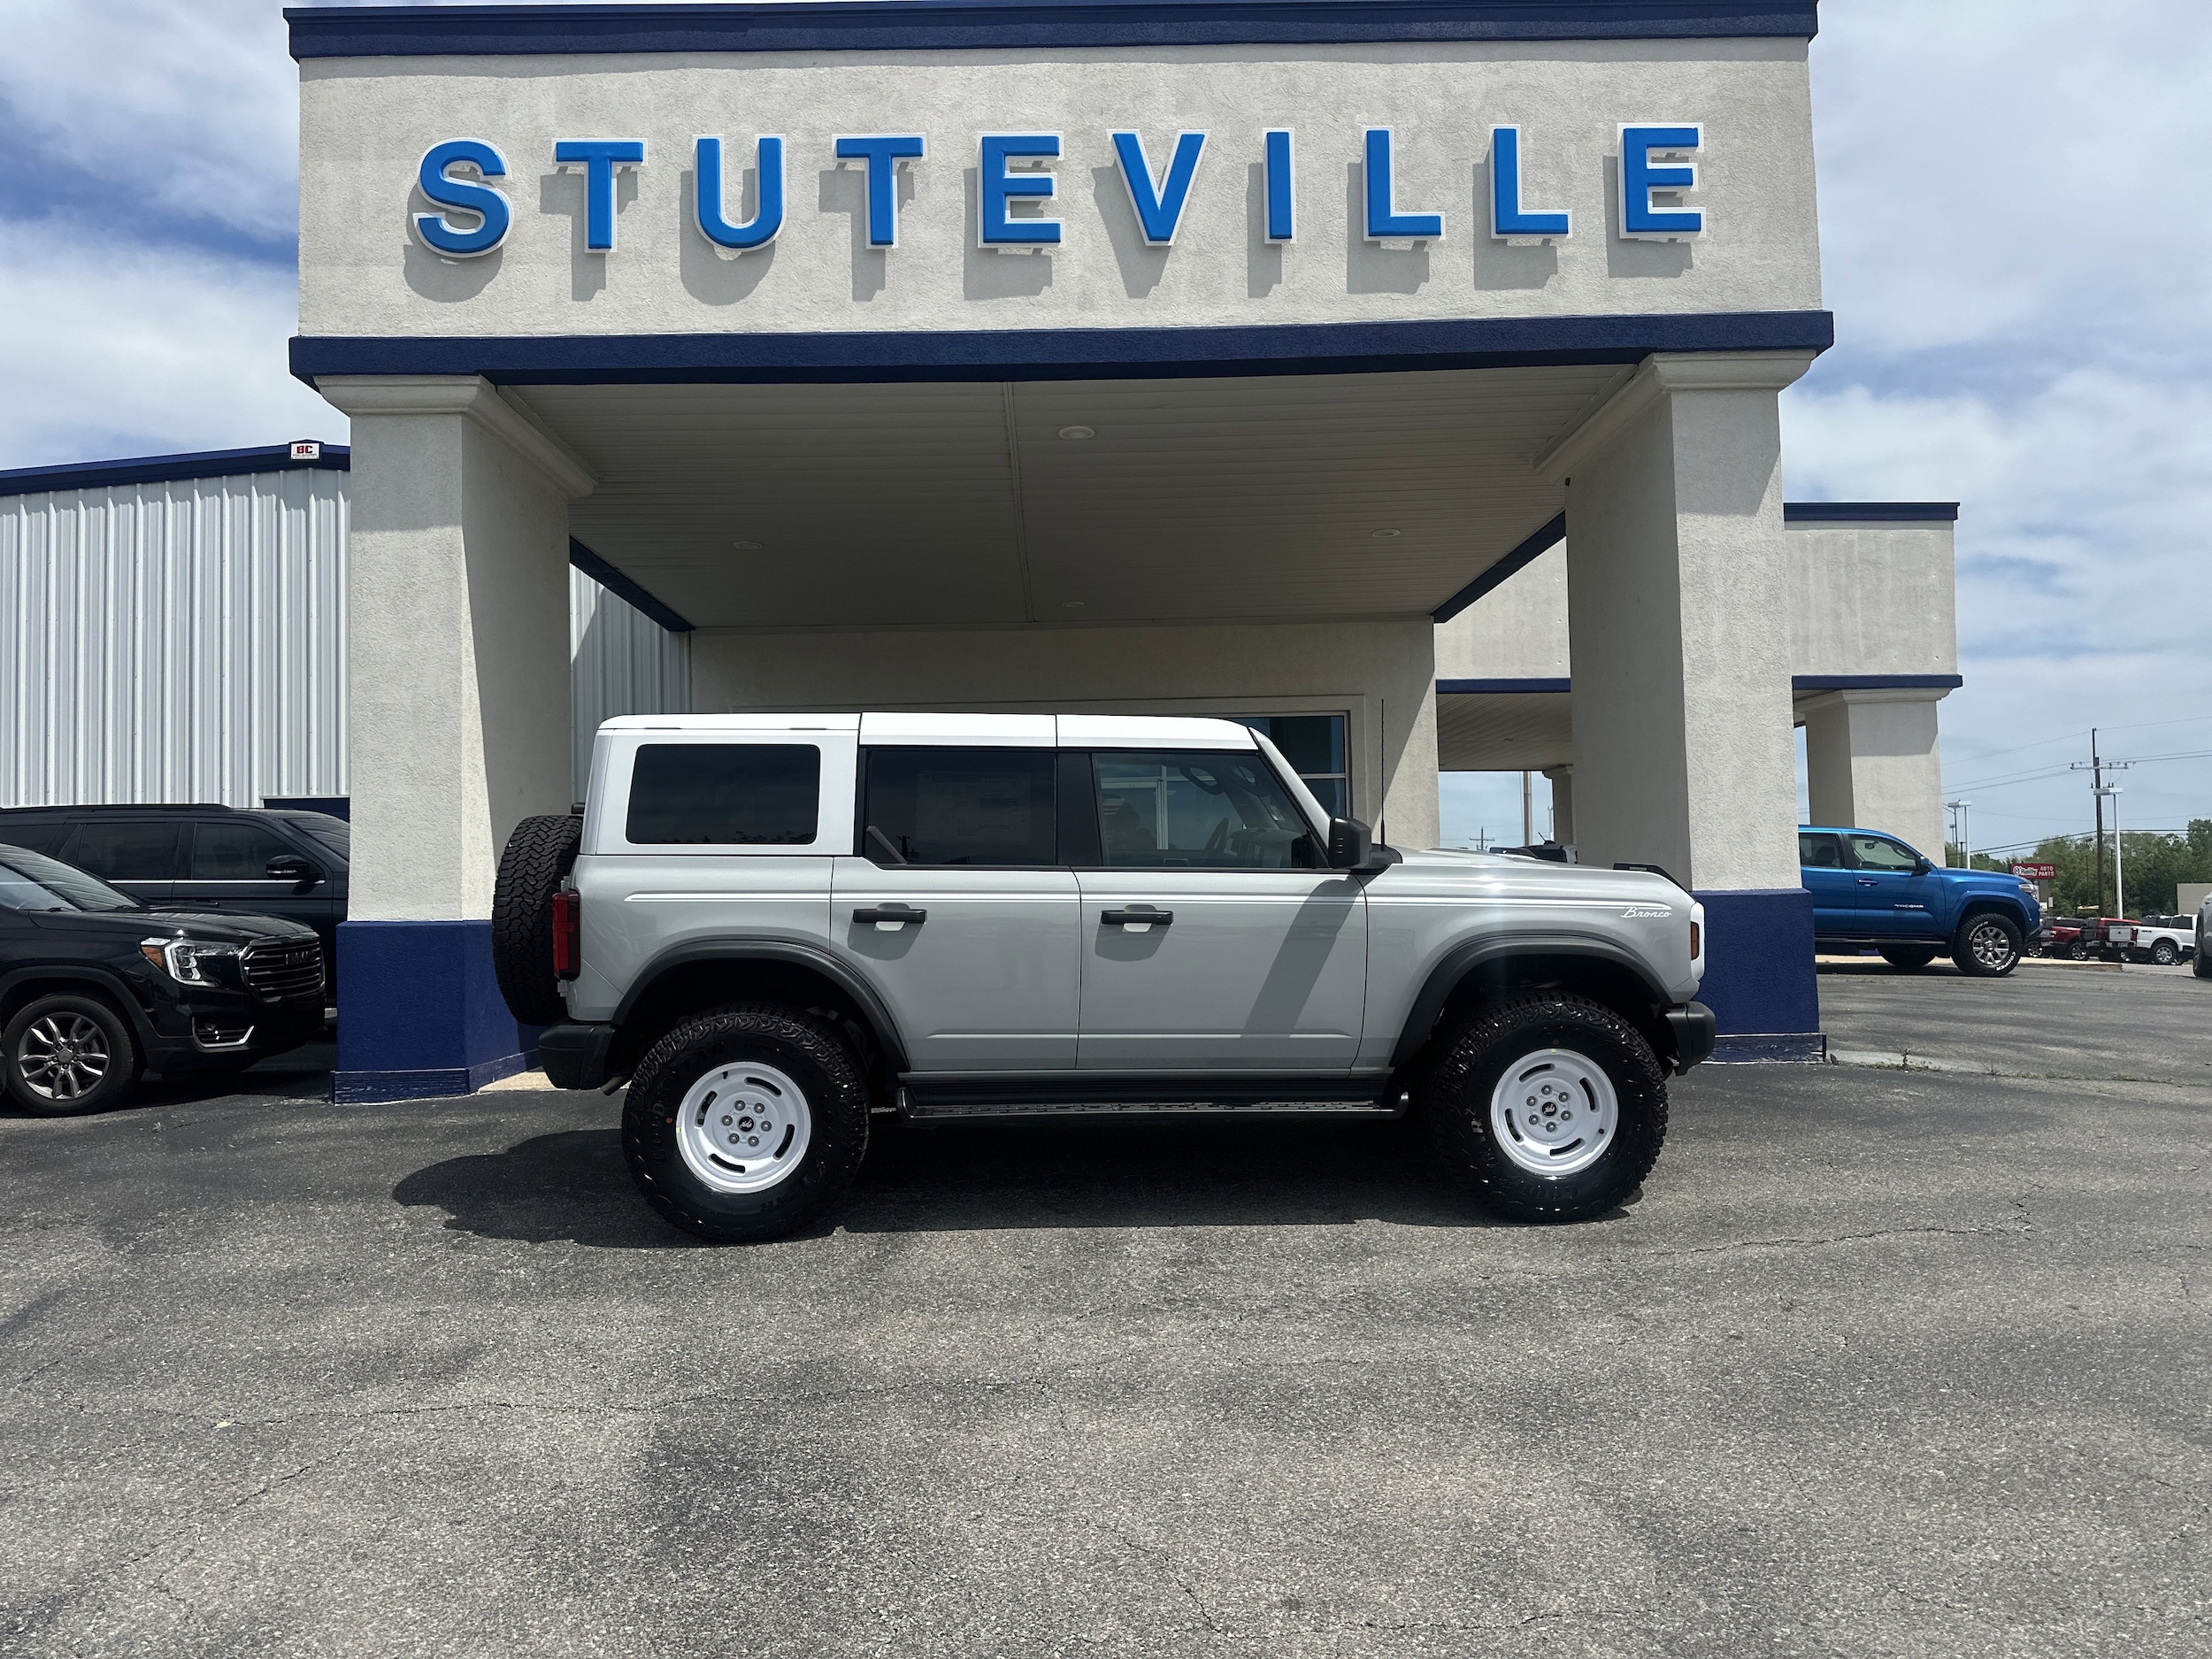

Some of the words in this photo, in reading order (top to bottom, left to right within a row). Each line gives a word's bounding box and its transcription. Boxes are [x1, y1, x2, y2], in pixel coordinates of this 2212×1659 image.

[413, 124, 1704, 256] STUTEVILLE
[2013, 866, 2038, 876] O'Reilly
[1620, 906, 1672, 918] Bronco
[1996, 951, 2016, 971] COOPER
